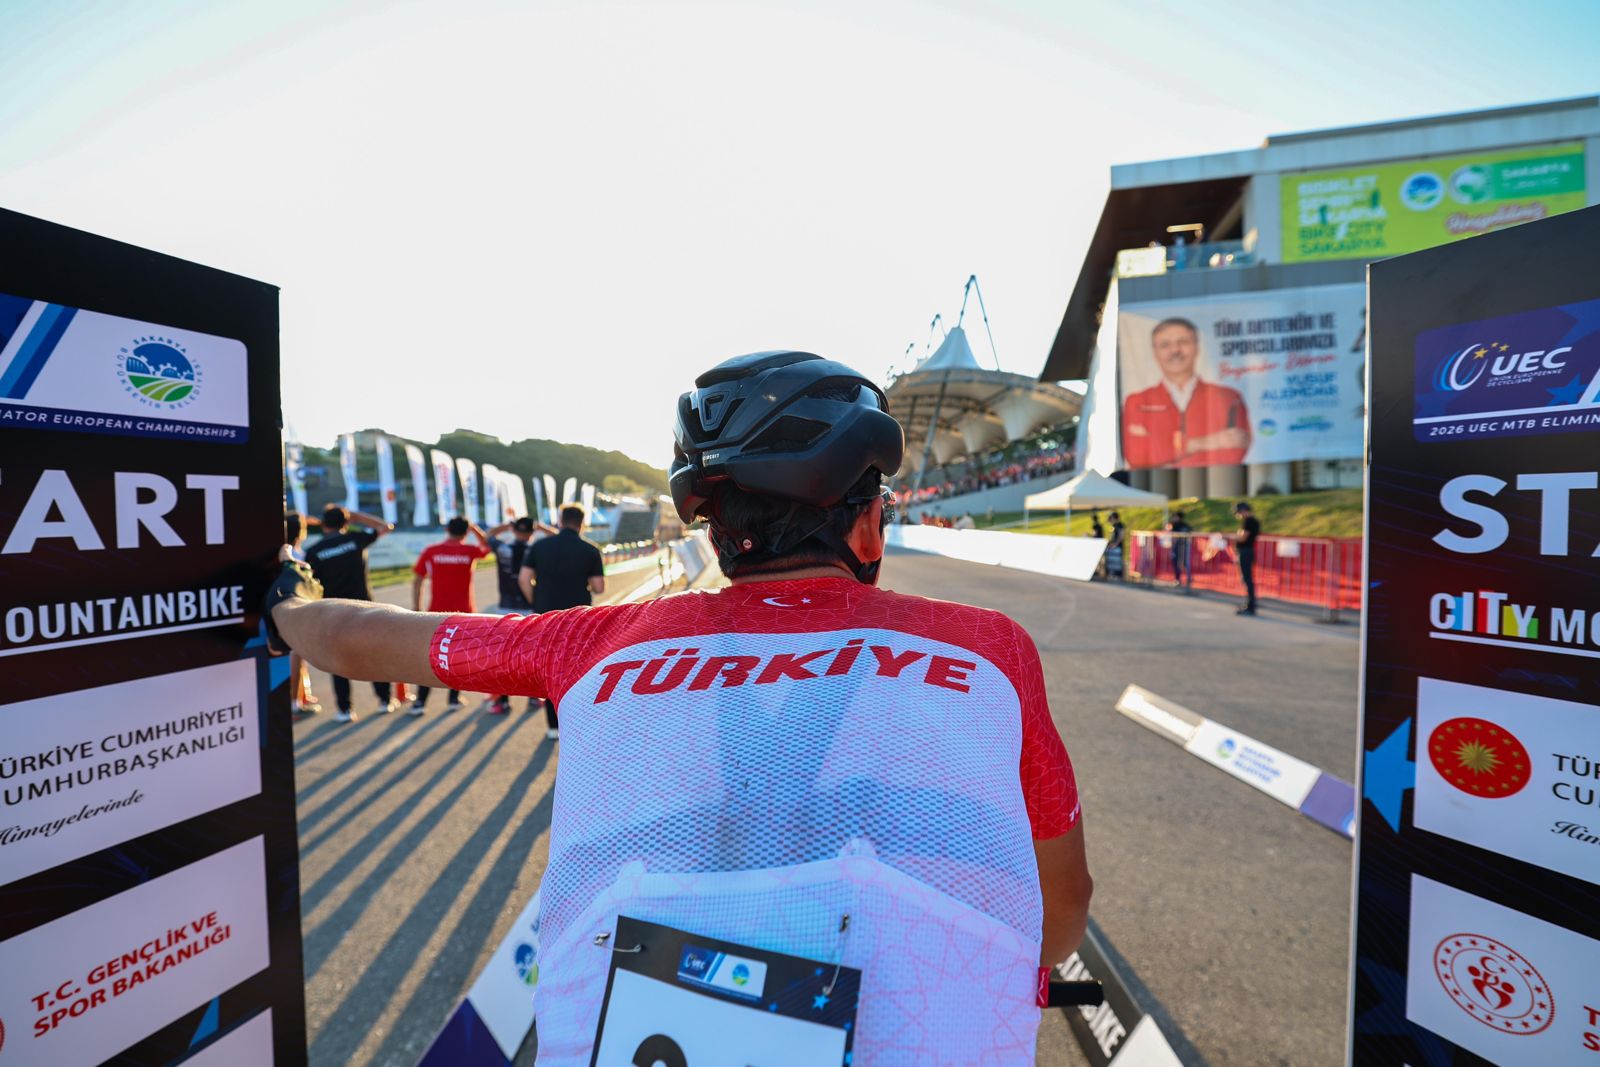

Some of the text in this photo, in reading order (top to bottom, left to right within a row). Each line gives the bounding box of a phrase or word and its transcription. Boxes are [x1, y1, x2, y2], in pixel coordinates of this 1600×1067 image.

[1491, 346, 1573, 376] UEC
[0, 410, 236, 438] ATOR EUROPEAN CHAMPIONSHIPS
[1429, 424, 1465, 436] 2026
[1469, 422, 1499, 433] UEC
[1501, 419, 1536, 431] MTB
[0, 468, 240, 555] ART
[1431, 471, 1600, 557] ST
[5, 586, 245, 644] OUNTAINBIKE
[1430, 591, 1537, 639] CITY
[593, 638, 977, 705] TÜRKİYE
[0, 702, 243, 779] ÜRKİYE CUMHURİYETİ
[4, 727, 245, 806] UMHURBAŞKANLIĞI
[1552, 782, 1600, 808] CU
[32, 911, 218, 1012] T.C. GENÇLİK VE
[34, 925, 231, 1038] SPOR BAKANLIĞI
